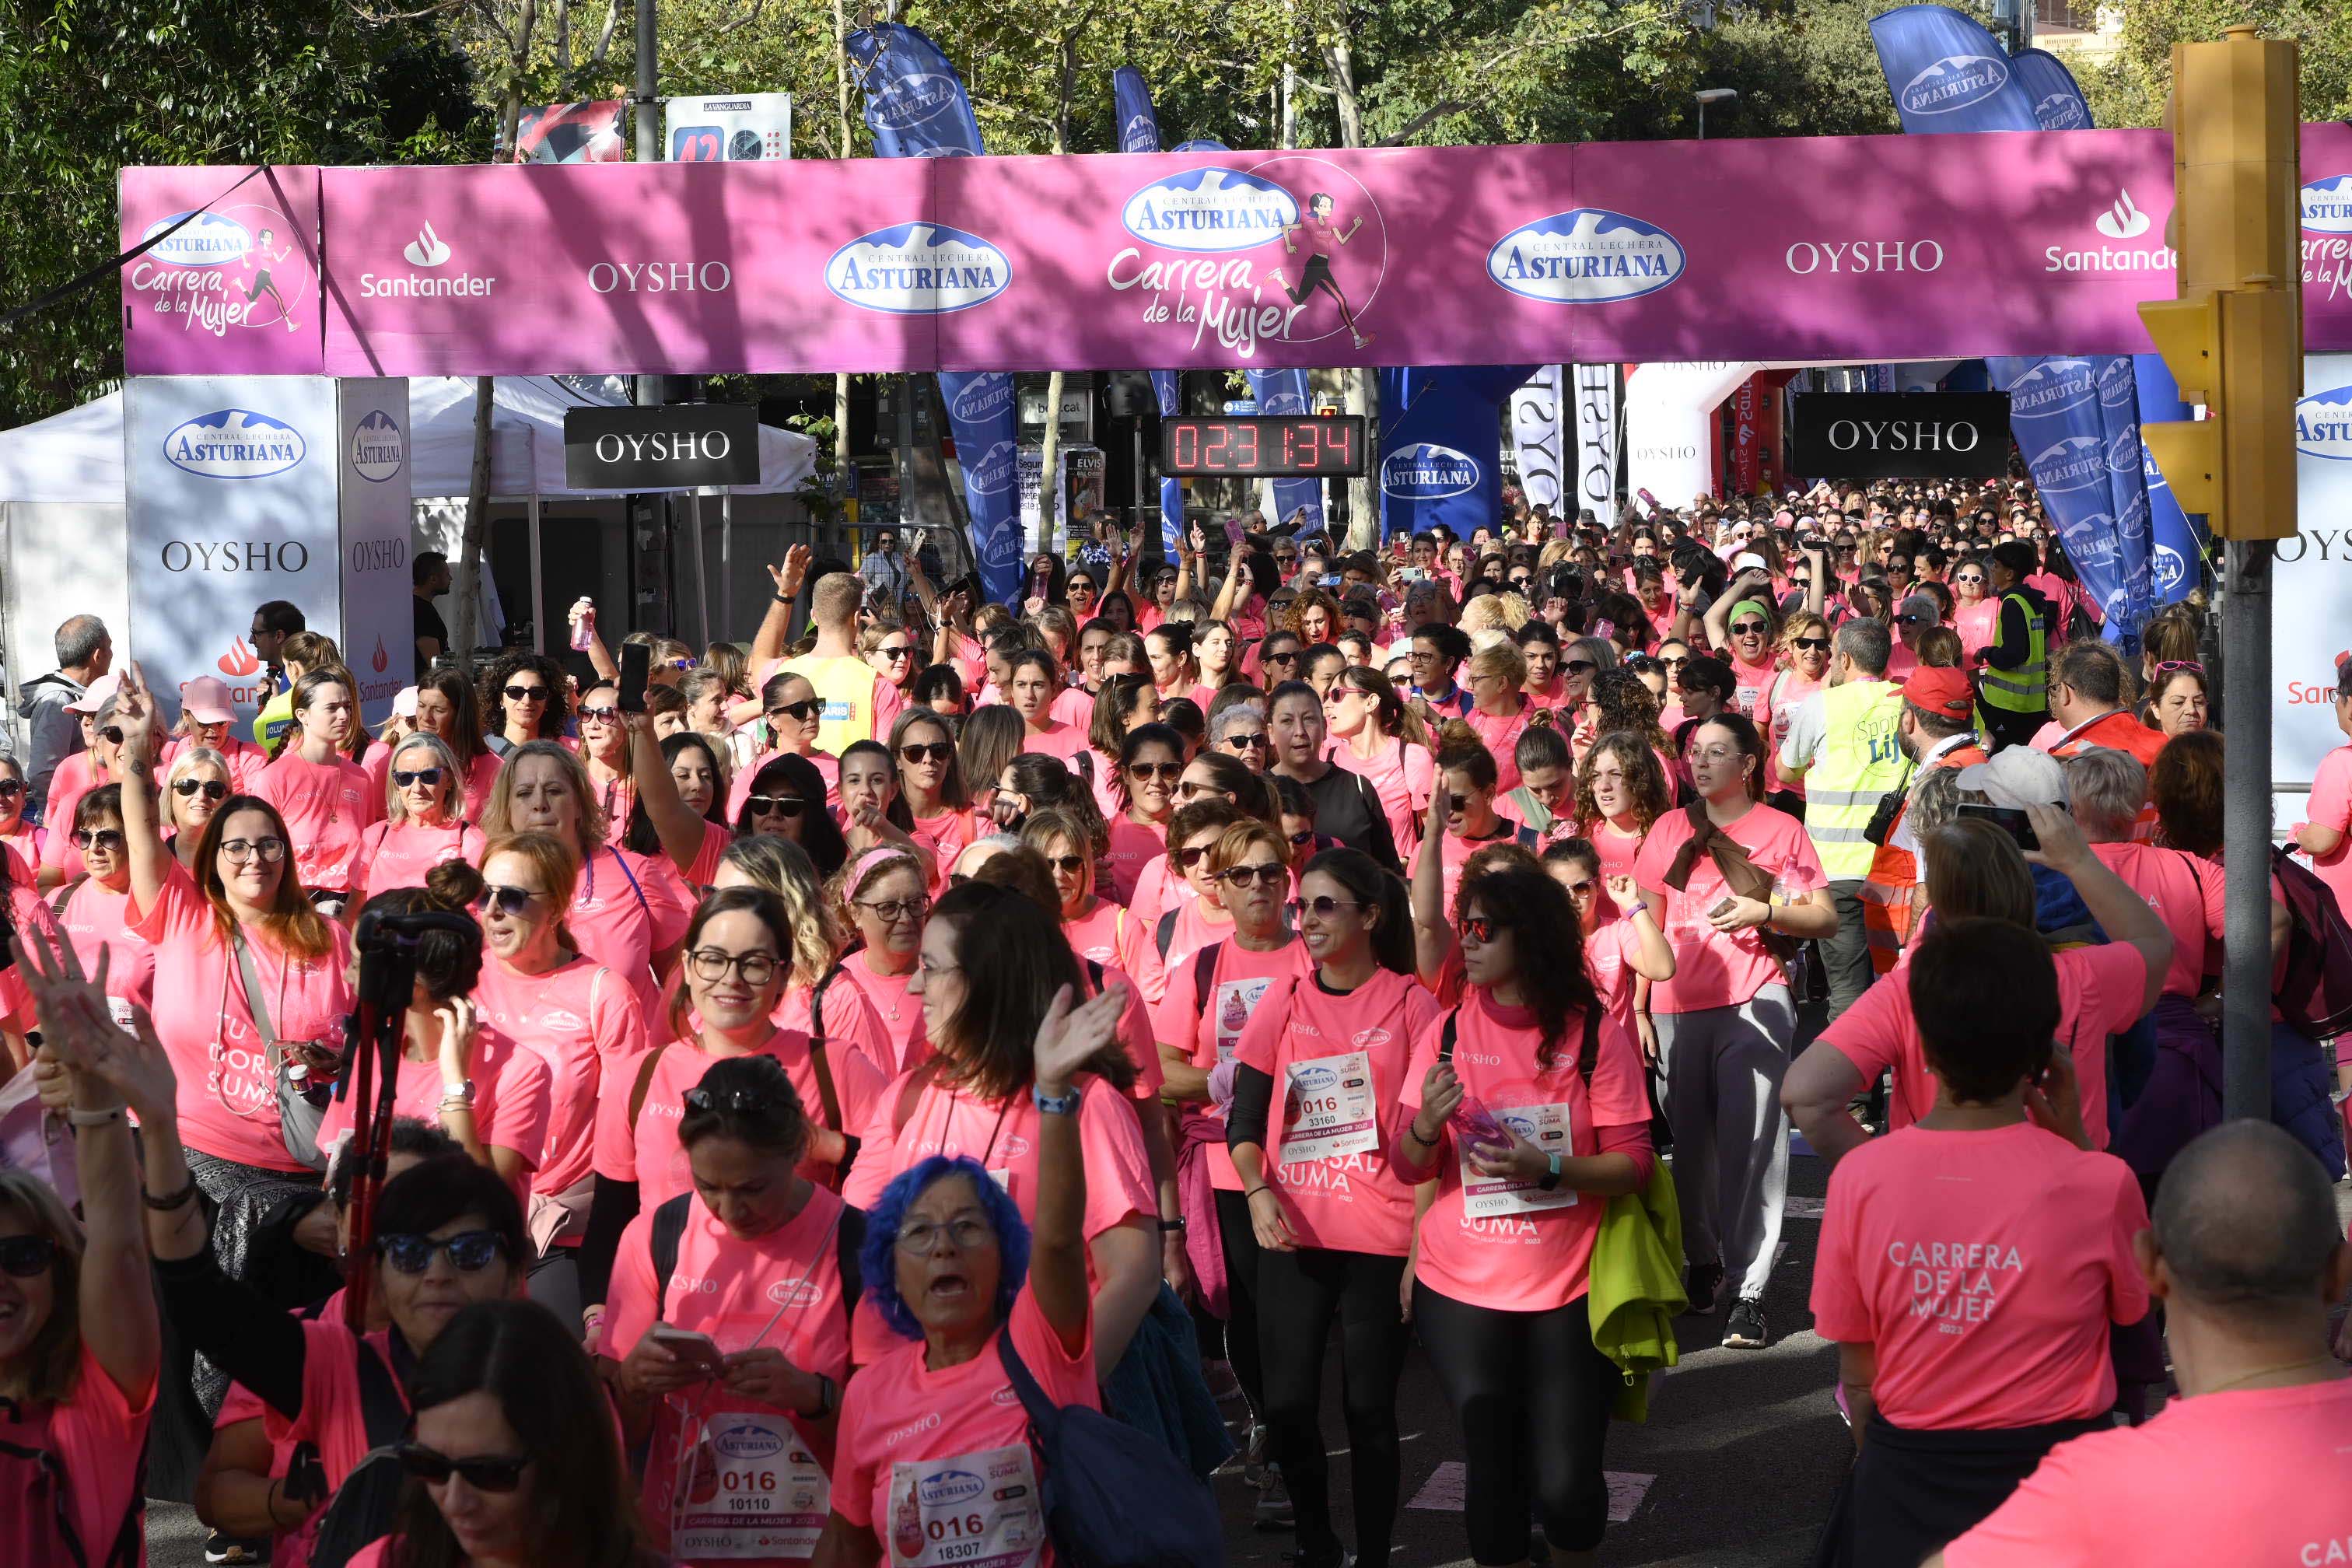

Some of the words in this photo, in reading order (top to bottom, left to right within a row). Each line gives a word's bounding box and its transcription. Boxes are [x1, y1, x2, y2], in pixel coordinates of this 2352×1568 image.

[1136, 199, 1285, 231] ASTURIANA
[1533, 242, 1594, 251] CENTRAL
[1601, 240, 1664, 250] LECHERA
[868, 254, 926, 263] CENTRAL
[933, 253, 992, 263] LECHERA
[1502, 244, 1670, 281] ASTURIANA
[1786, 239, 1944, 275] OYSHO
[131, 263, 224, 292] Carrera
[588, 261, 731, 294] OYSHO
[839, 256, 996, 291] ASTURIANA
[1108, 247, 1254, 292] Carrera
[2318, 261, 2331, 282] la
[360, 273, 495, 298] Santander
[155, 292, 171, 313] de
[175, 292, 187, 313] la
[185, 288, 258, 338] Mujer
[1143, 293, 1170, 324] de
[1176, 292, 1195, 324] la
[1191, 285, 1307, 359] Mujer
[1829, 420, 1979, 452] OYSHO
[2297, 418, 2352, 442] ASTU
[175, 435, 295, 462] ASTURIANA
[355, 444, 401, 464] ASTURIANA
[596, 430, 730, 464] OYSHO
[1077, 459, 1101, 468] ELVIS
[1019, 471, 1031, 480] que
[1384, 466, 1472, 488] ASTURIANA
[161, 541, 309, 572] OYSHO
[353, 537, 405, 573] OYSHO
[360, 677, 404, 702] Santander
[1857, 712, 1899, 740] Spor
[1868, 730, 1899, 765] Lif
[1106, 852, 1137, 860] OYSHO
[1297, 1075, 1335, 1087] ASTURIANA
[1303, 1097, 1337, 1115] 016
[1309, 1115, 1335, 1127] 33160
[1288, 1132, 1314, 1140] CARRERA
[1331, 1125, 1353, 1135] MUJER
[1288, 1145, 1316, 1156] OYSHO
[1276, 1164, 1350, 1193] SUMA
[1476, 1184, 1507, 1193] CARRERA
[1475, 1199, 1508, 1209] OYSHO
[1888, 1241, 2022, 1272] CARRERA
[1914, 1269, 1951, 1295] DE
[1959, 1271, 1995, 1296] LA
[1939, 1323, 1964, 1335] 2023
[720, 1438, 779, 1451] ASTURIANA
[723, 1471, 776, 1491] 016
[989, 1468, 1021, 1479] SUMA
[921, 1482, 980, 1500] ASTURIANA
[729, 1498, 770, 1510] 10110
[689, 1517, 730, 1526] CARRERA
[732, 1517, 744, 1526] DE
[746, 1517, 758, 1526] LA
[761, 1517, 793, 1526] MUJER
[927, 1514, 984, 1541] 016
[684, 1536, 732, 1549] OYSHO
[937, 1542, 981, 1561] 18307
